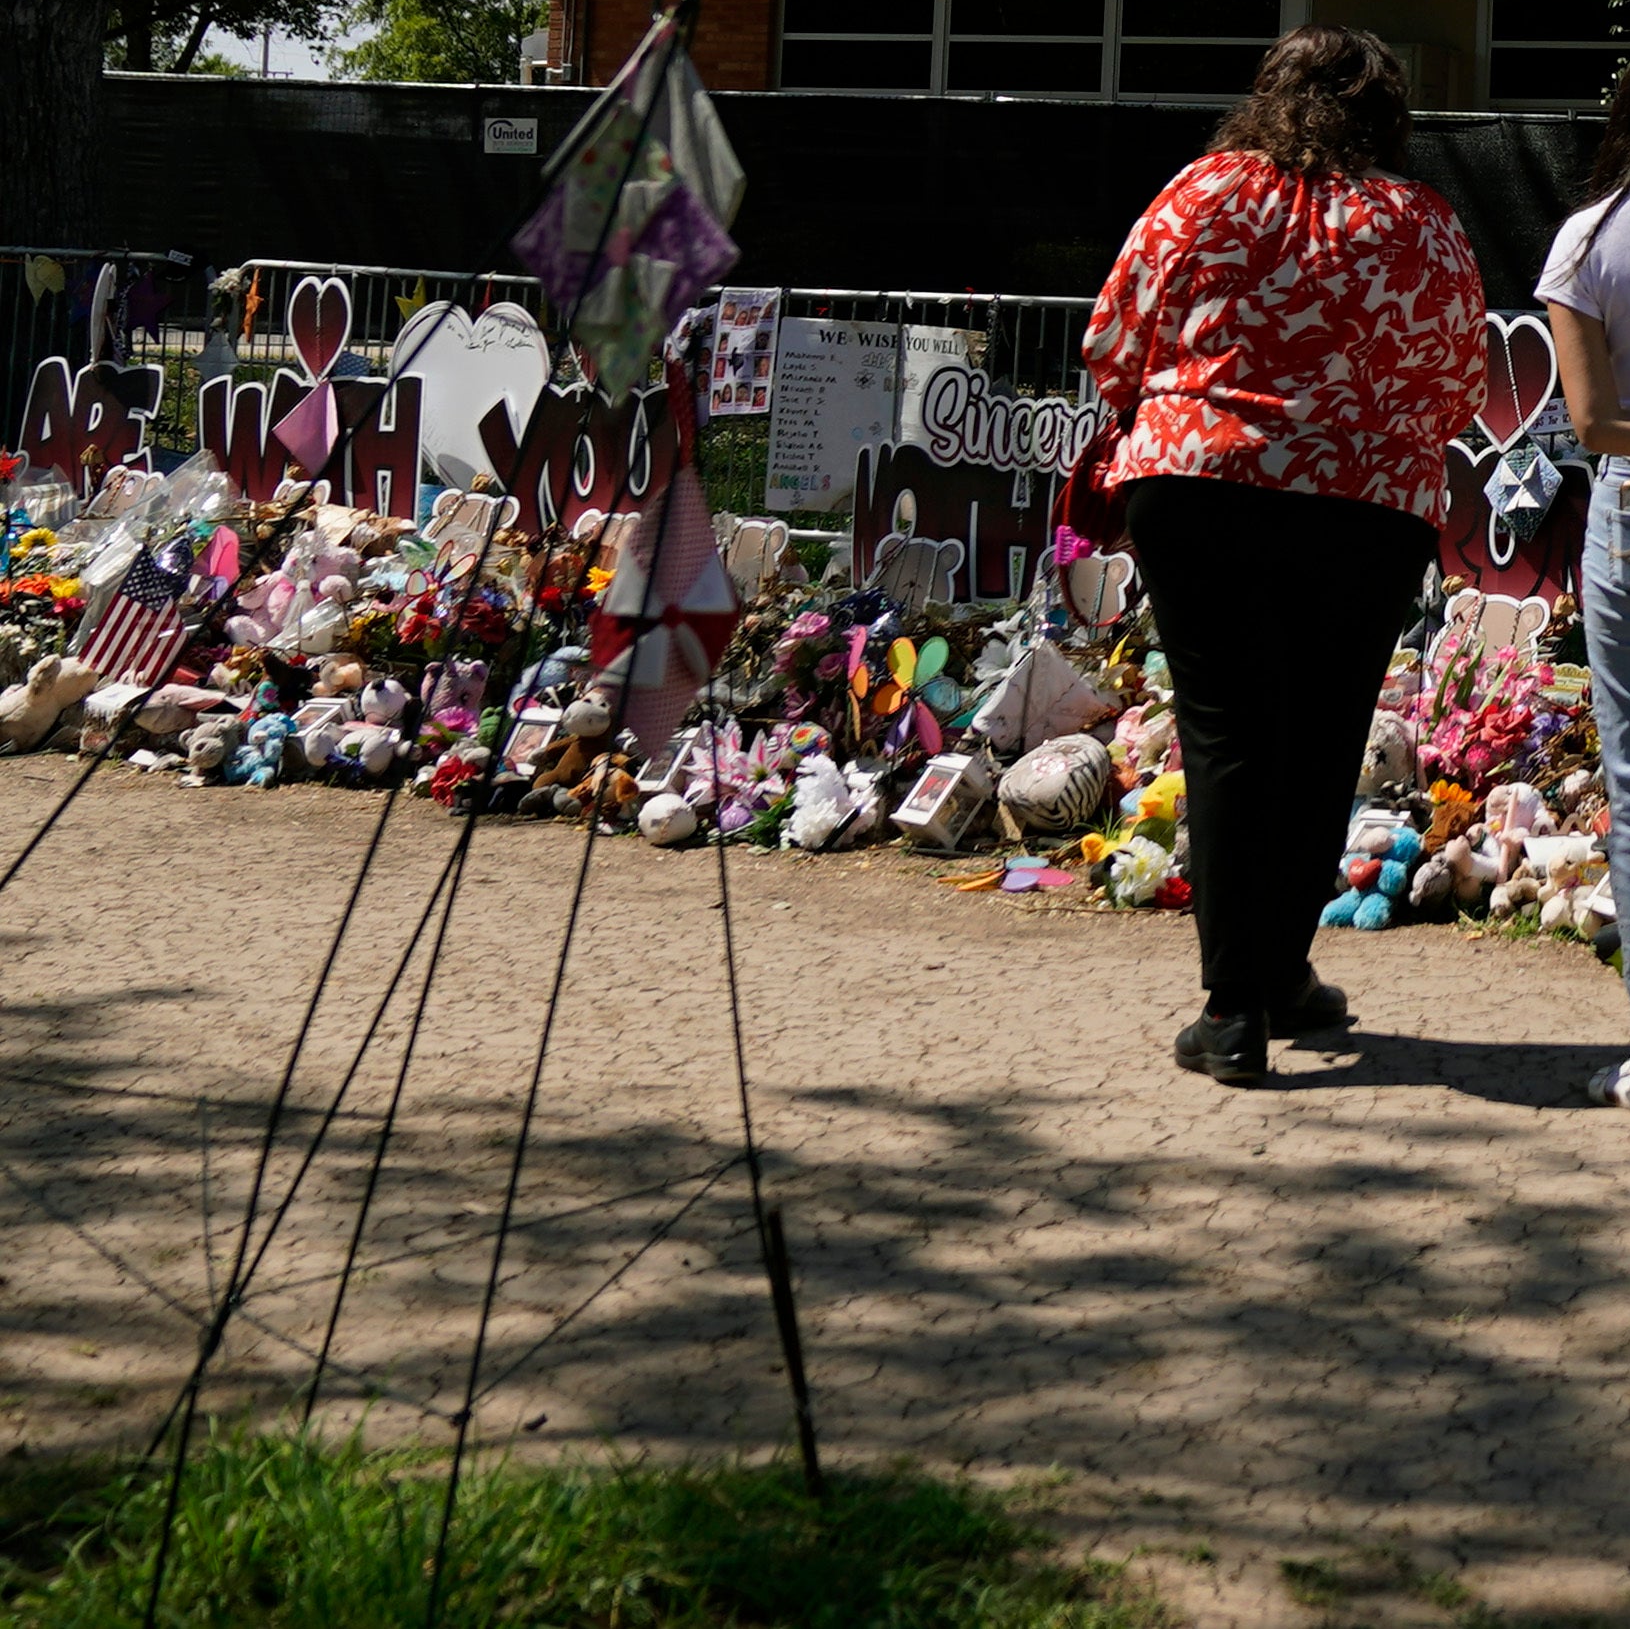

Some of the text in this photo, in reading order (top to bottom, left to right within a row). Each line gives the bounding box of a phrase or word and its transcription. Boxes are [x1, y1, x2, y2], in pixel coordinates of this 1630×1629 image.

[492, 127, 534, 140] United
[819, 330, 848, 346] WE
[906, 336, 929, 353] YOU
[932, 339, 960, 356] WELL
[18, 357, 163, 508] ARE
[769, 473, 831, 491] ANGELS
